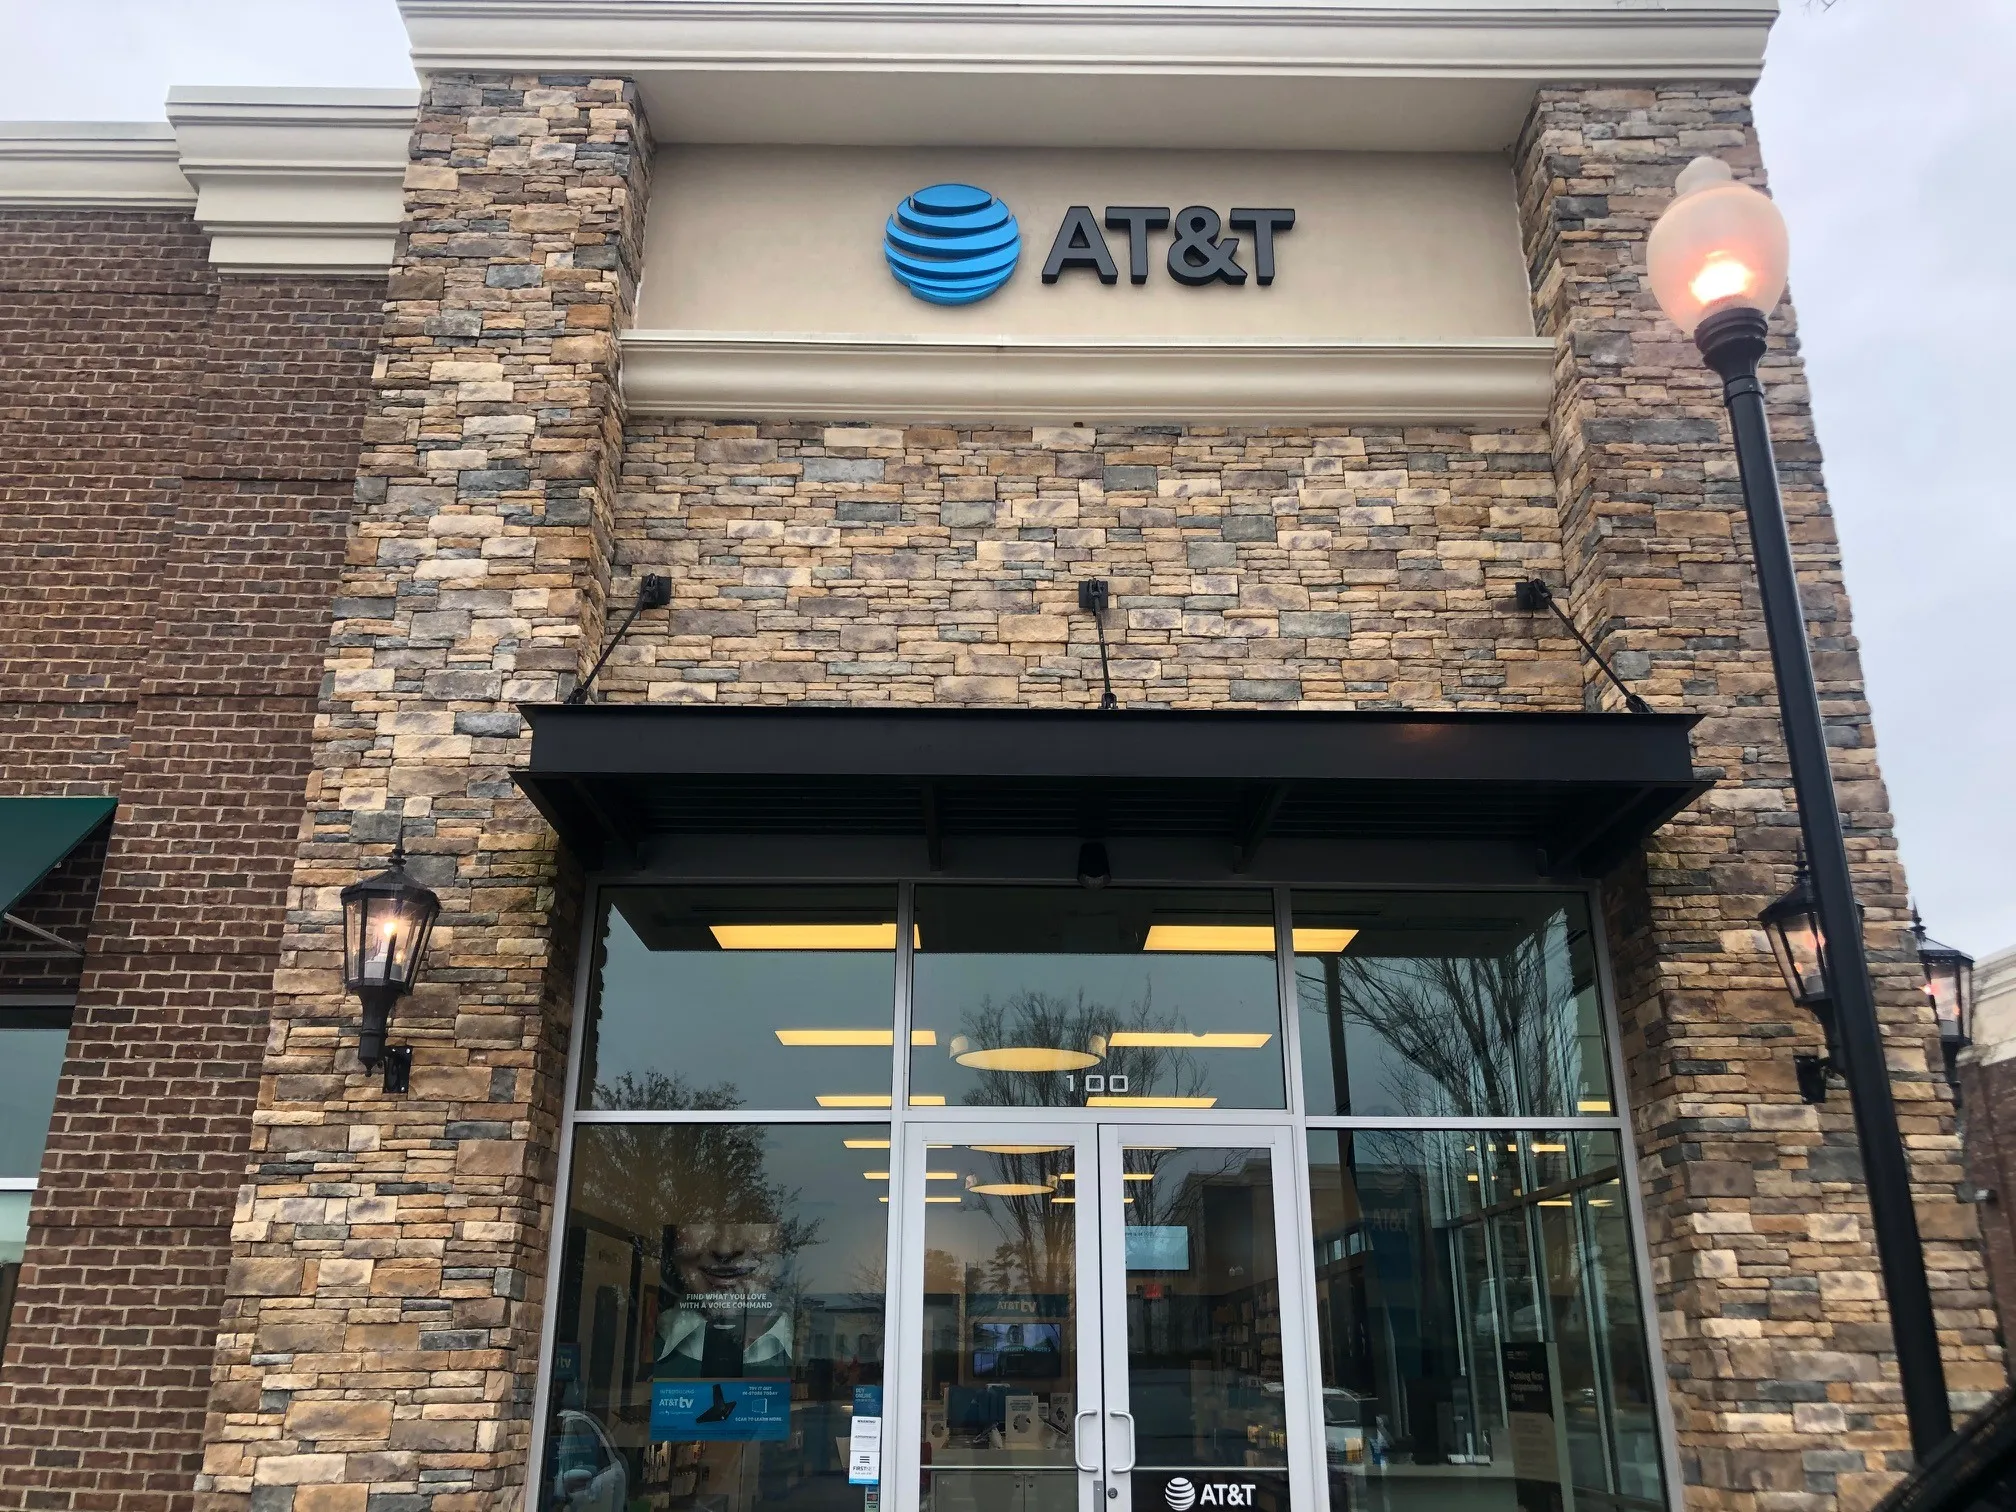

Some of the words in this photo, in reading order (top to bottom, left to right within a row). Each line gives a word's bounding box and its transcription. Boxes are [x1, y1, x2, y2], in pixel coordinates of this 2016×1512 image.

[1041, 205, 1296, 286] AT&T
[1066, 1074, 1129, 1092] 100
[680, 1301, 700, 1309] WITH
[701, 1301, 707, 1309] A
[708, 1301, 731, 1309] VOICE
[732, 1301, 773, 1309] COMMAND
[996, 1301, 1020, 1310] AT&T
[659, 1398, 679, 1407] AT&T
[679, 1396, 694, 1409] tv
[1199, 1483, 1257, 1506] AT&T
